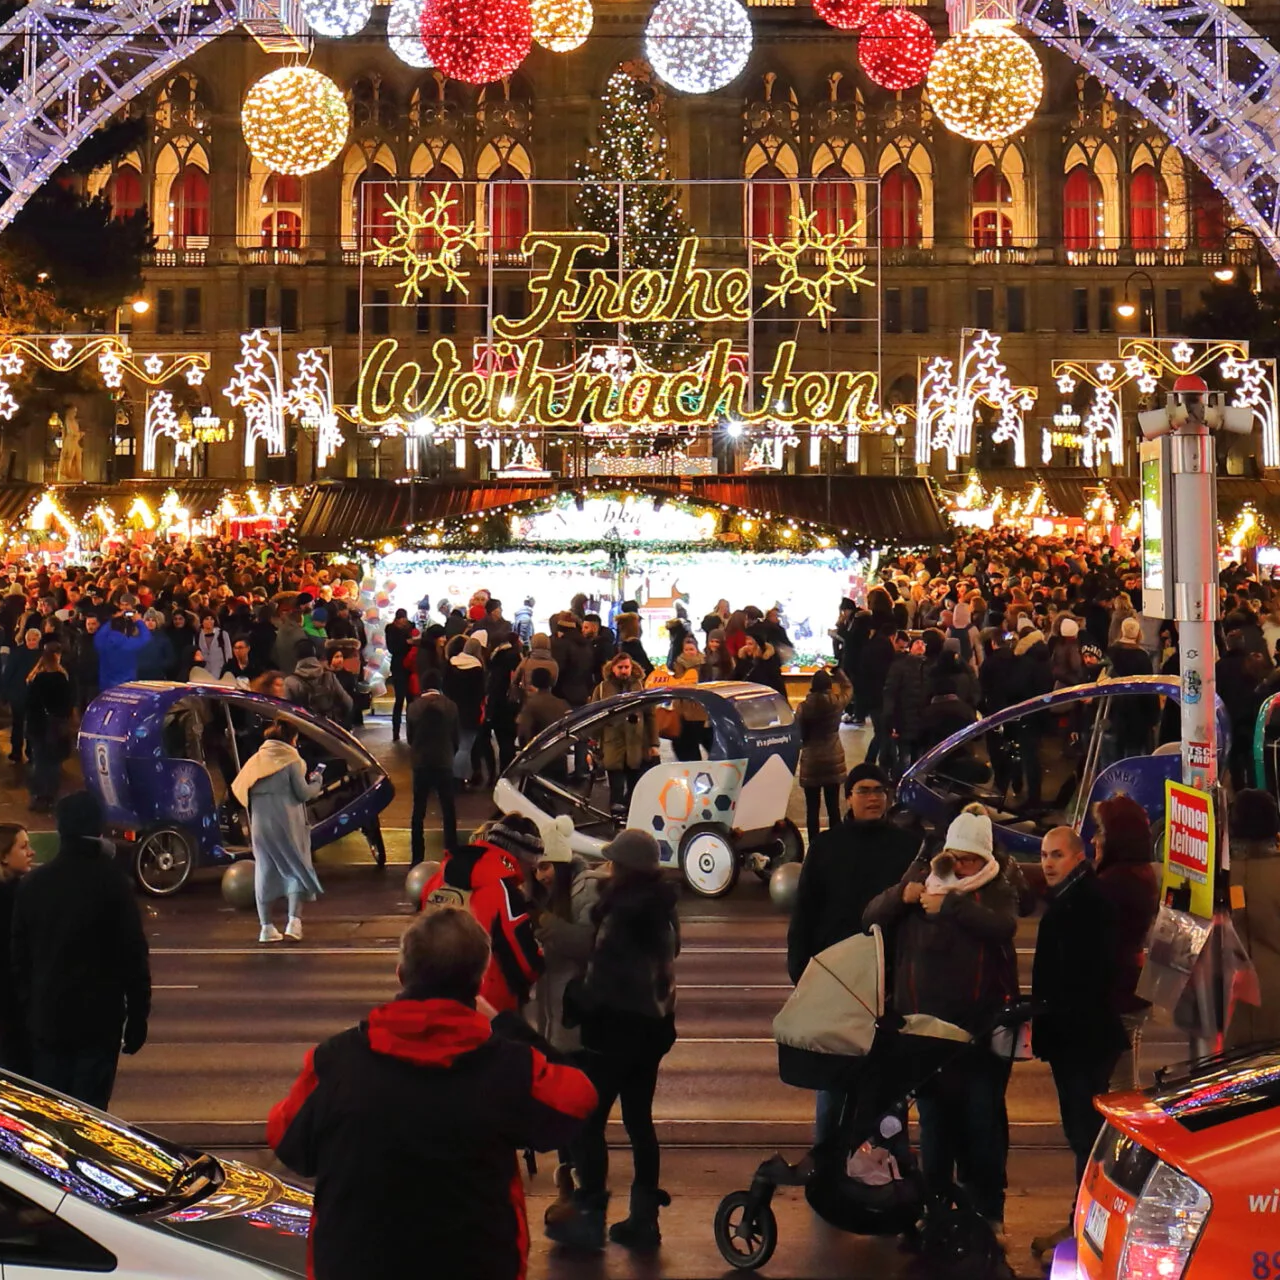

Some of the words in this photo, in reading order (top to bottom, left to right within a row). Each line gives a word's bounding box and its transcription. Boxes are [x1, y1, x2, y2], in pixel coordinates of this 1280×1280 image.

[492, 230, 753, 340] Frohe
[357, 337, 882, 427] Weihnachten
[1171, 795, 1209, 834] Kronen
[1171, 824, 1209, 866] Zeitung
